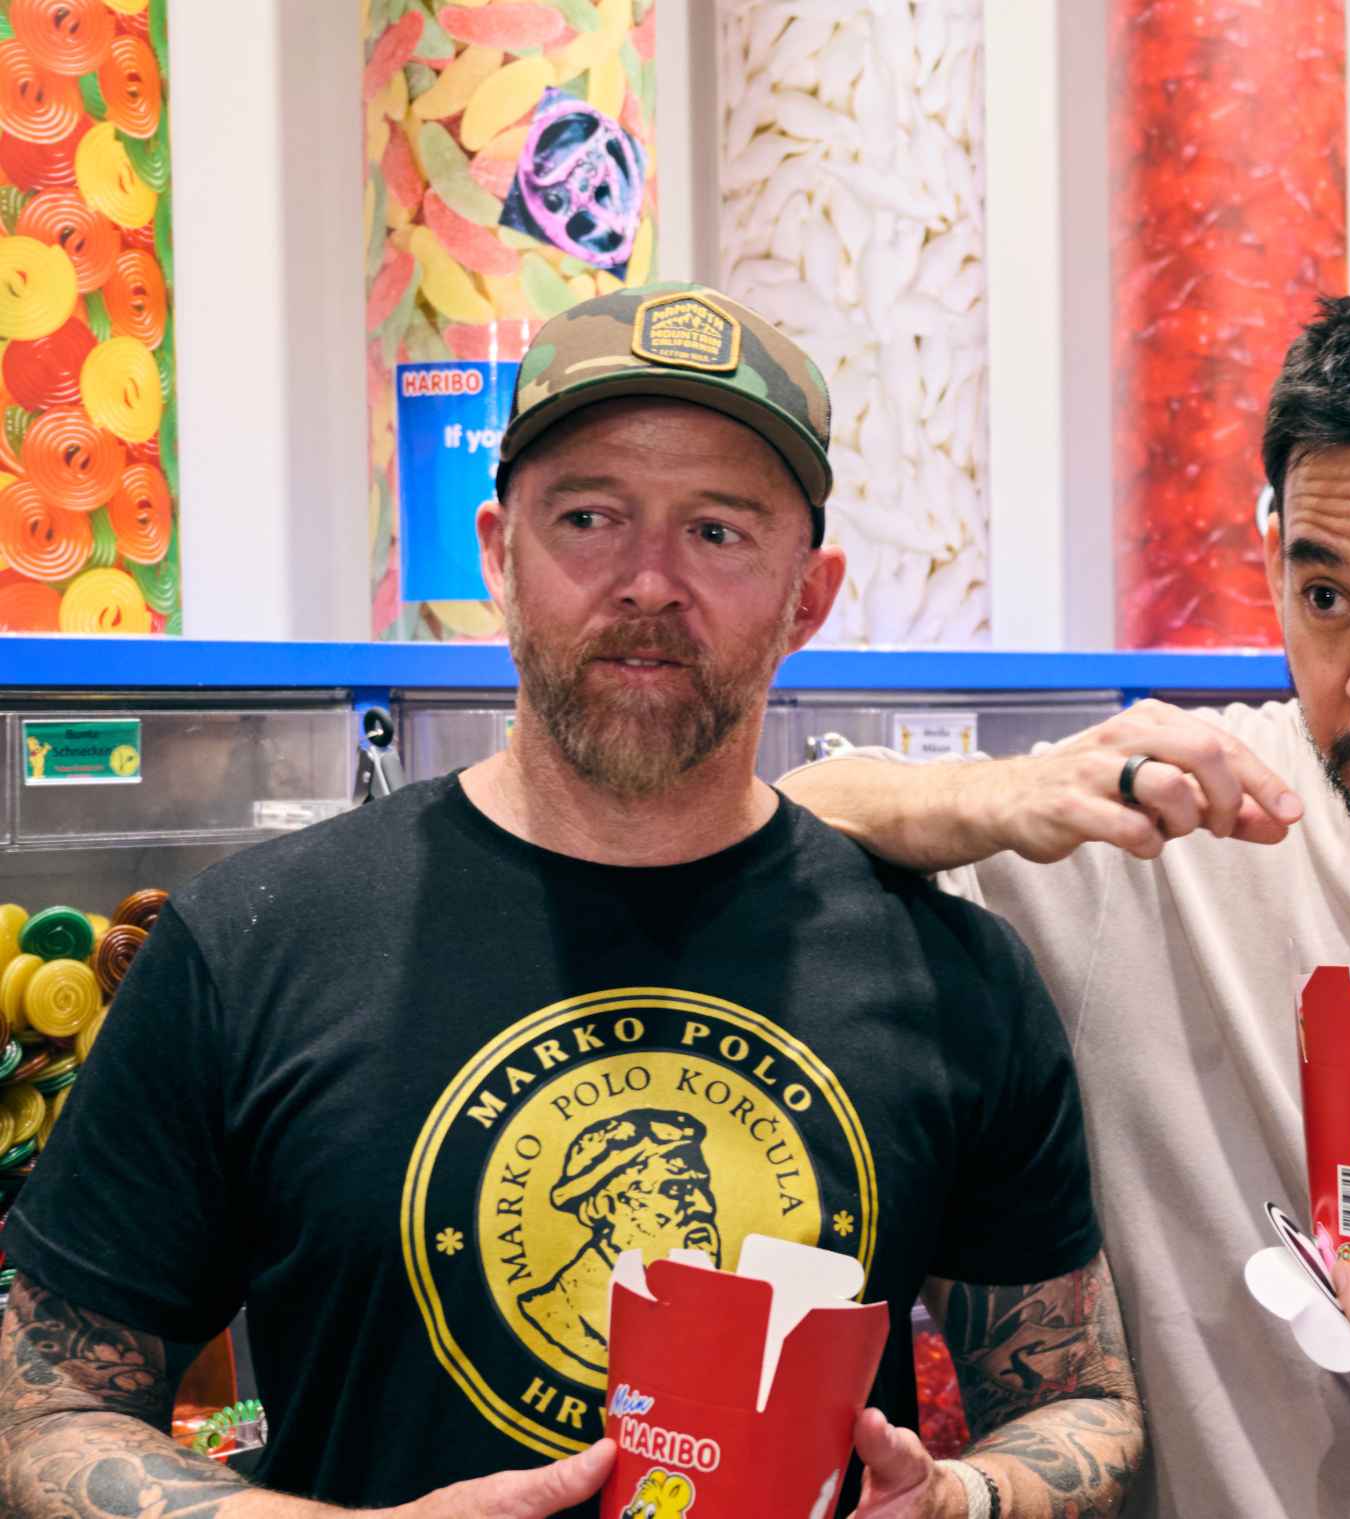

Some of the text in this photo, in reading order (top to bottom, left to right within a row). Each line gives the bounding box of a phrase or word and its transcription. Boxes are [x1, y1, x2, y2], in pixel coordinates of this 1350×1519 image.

[403, 370, 482, 396] HARIBO
[444, 424, 462, 449] If
[466, 1017, 813, 1129] MARKO POLO
[496, 1066, 804, 1285] MARKO POLO KORČULA
[619, 1415, 721, 1473] HARIBO
